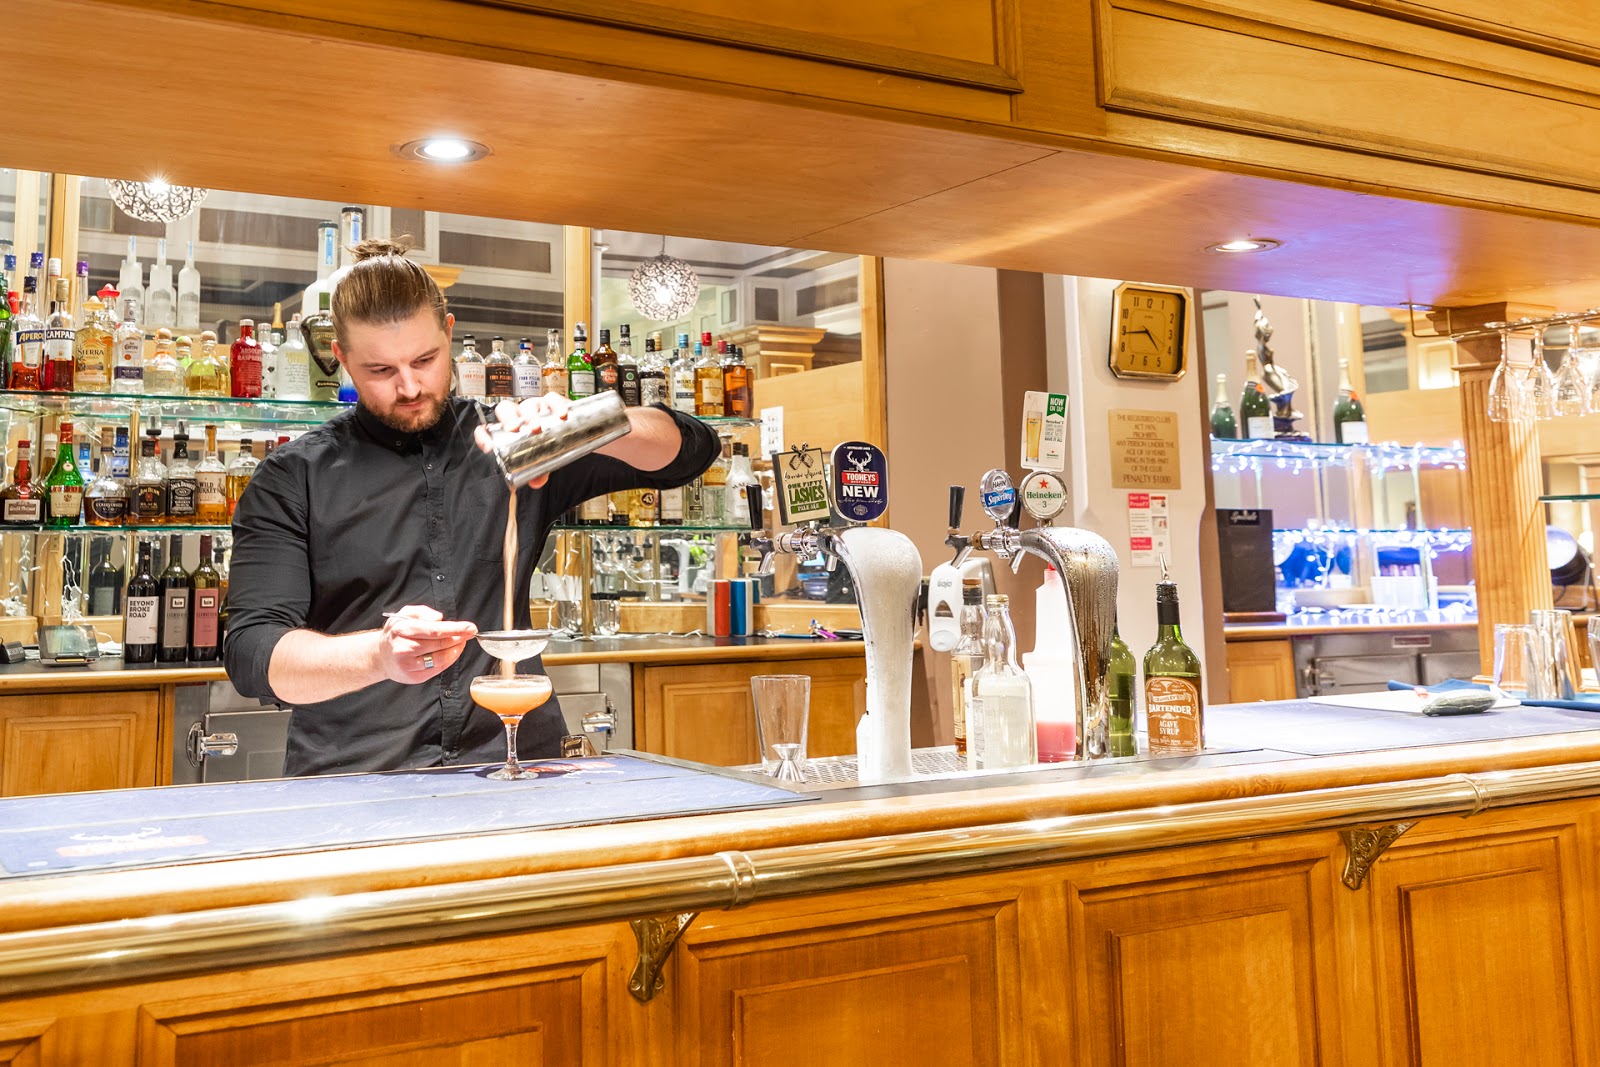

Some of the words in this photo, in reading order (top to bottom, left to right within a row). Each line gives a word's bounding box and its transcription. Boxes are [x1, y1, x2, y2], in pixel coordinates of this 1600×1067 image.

[1134, 297, 1139, 307] 11
[1147, 298, 1153, 308] 12
[1123, 309, 1128, 319] 10
[1170, 314, 1174, 324] 2
[1122, 325, 1126, 336] 9
[1168, 330, 1173, 340] 3
[1121, 342, 1125, 352] 8
[1168, 346, 1171, 356] 4
[1131, 355, 1134, 365] 7
[1143, 356, 1147, 366] 6
[1157, 357, 1161, 367] 5
[1050, 397, 1065, 406] NOW
[846, 473, 876, 481] TOOHEYS
[1123, 474, 1151, 483] PENALTY
[789, 485, 825, 505] LASHES
[842, 485, 879, 498] NEW
[1026, 491, 1062, 499] Heineken
[642, 494, 654, 503] 43
[1149, 704, 1192, 715] BARTENDER
